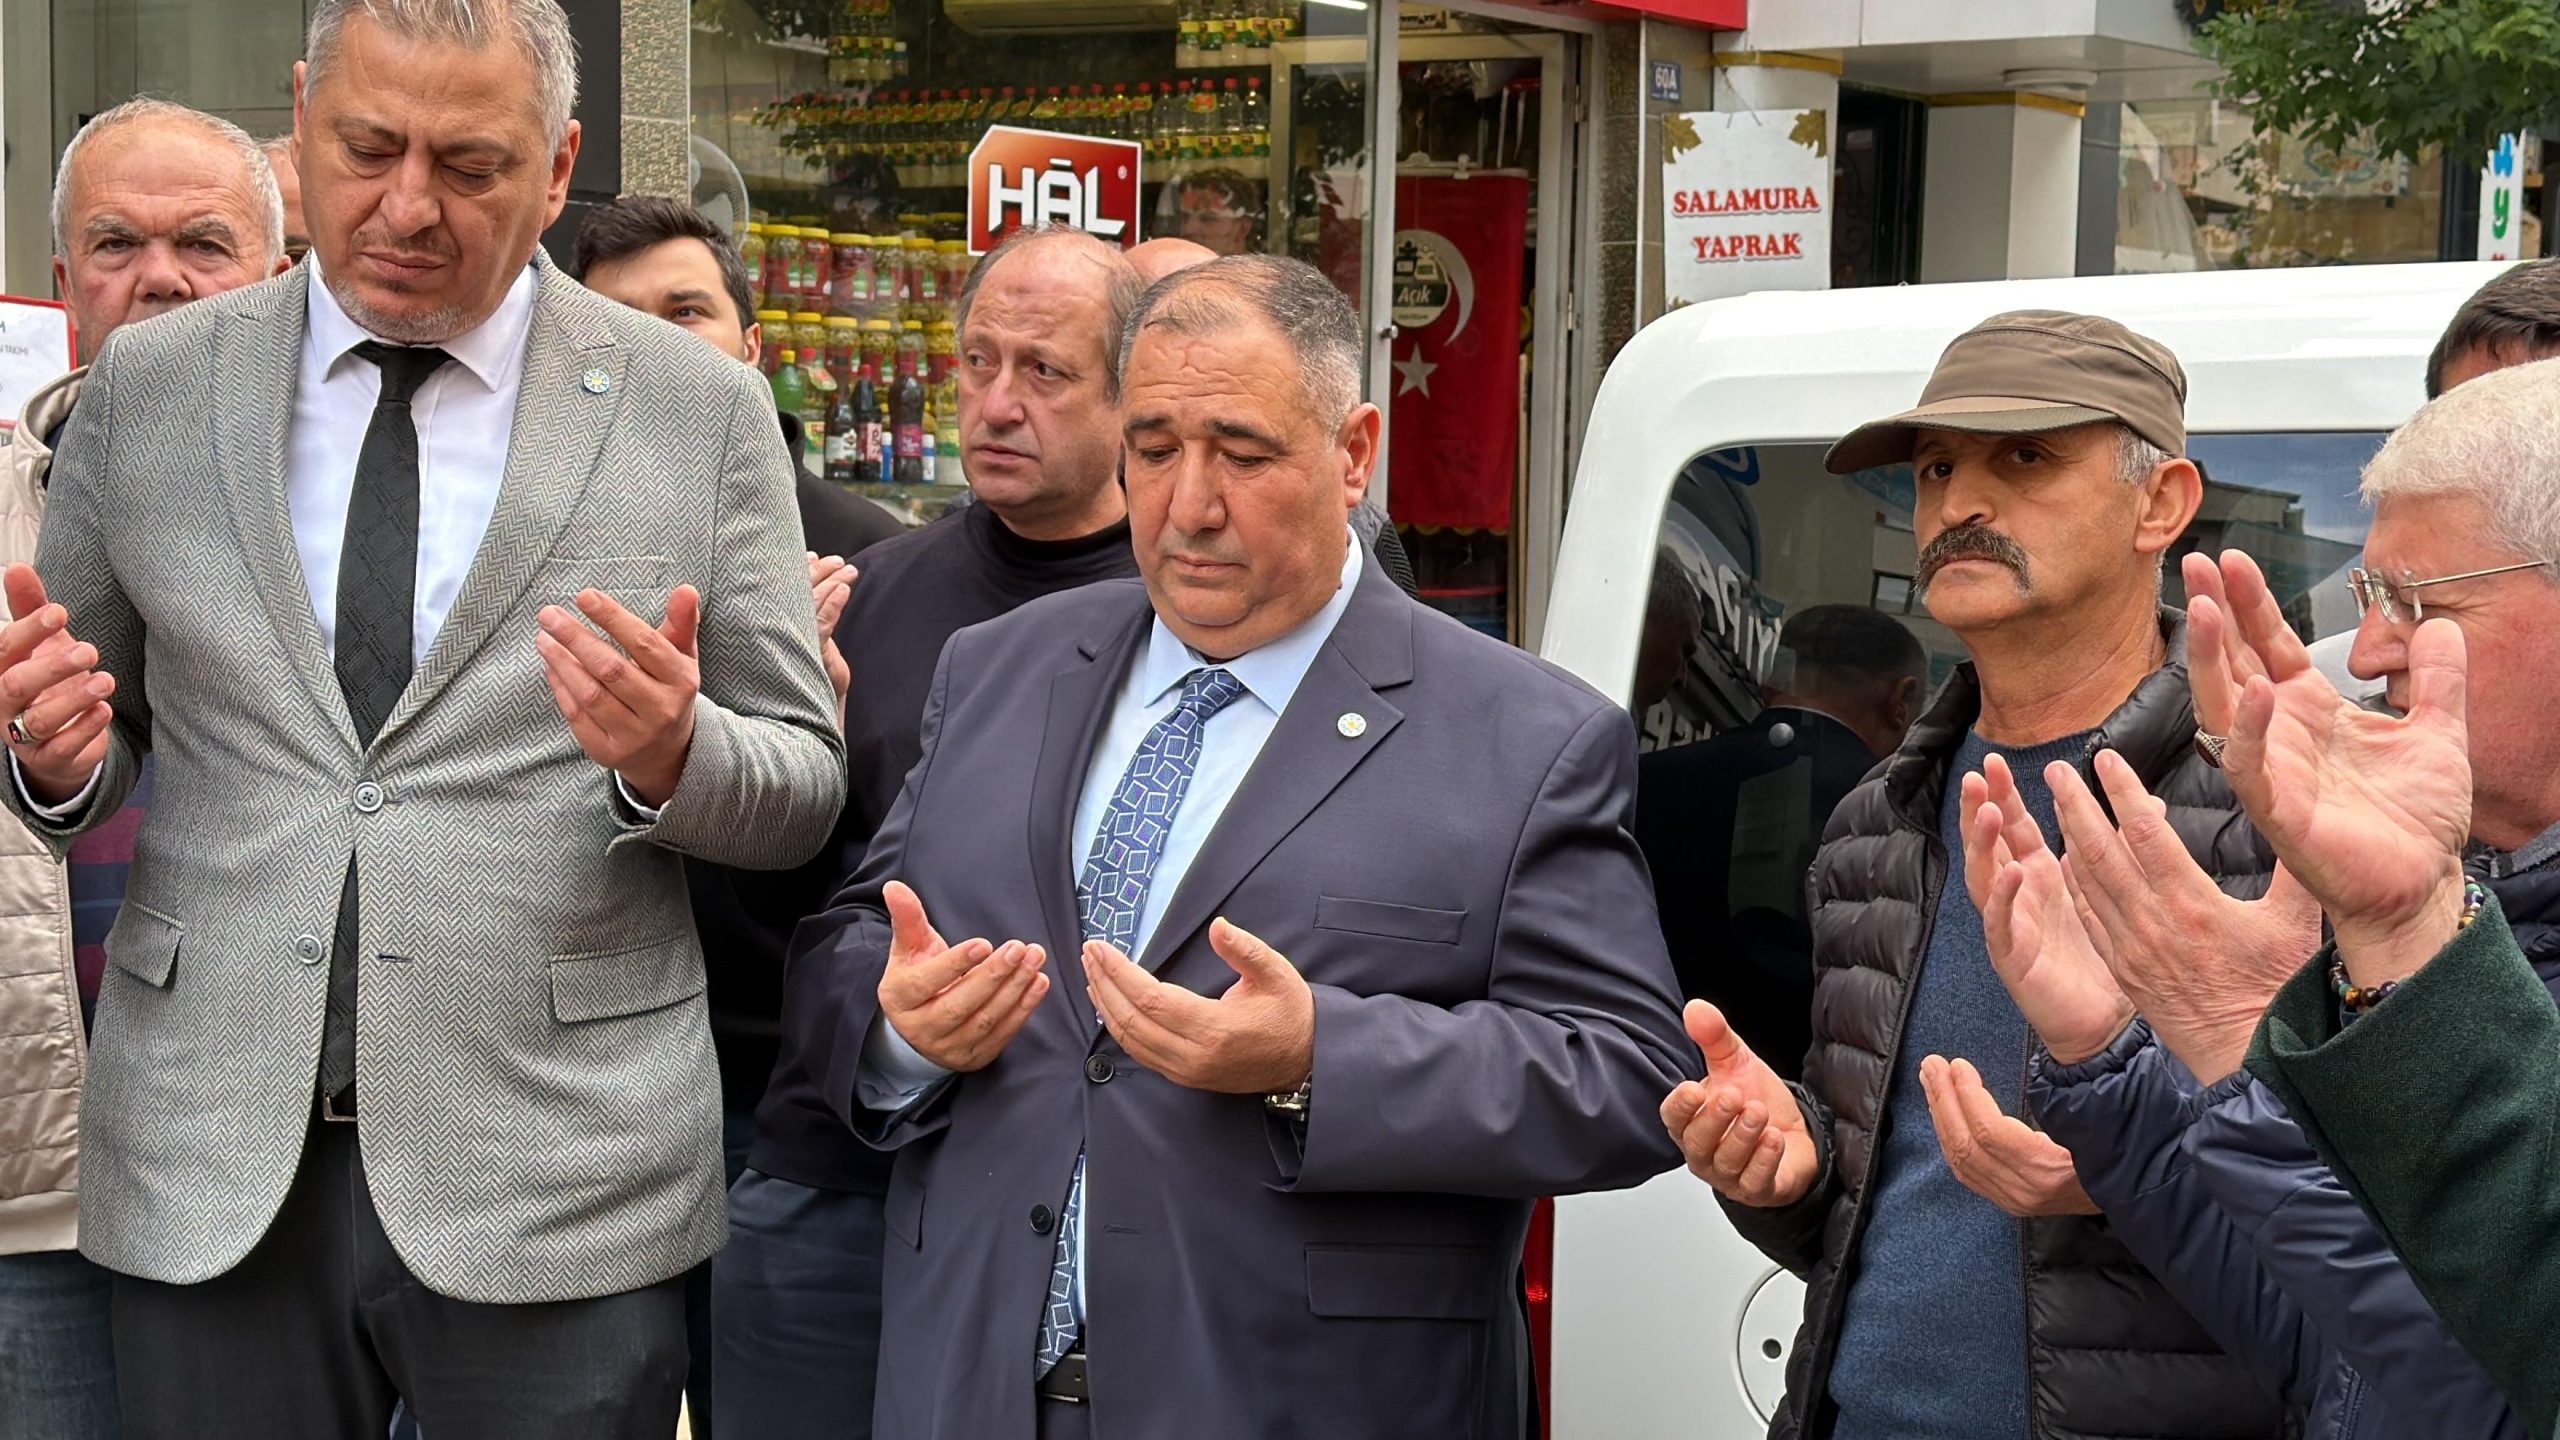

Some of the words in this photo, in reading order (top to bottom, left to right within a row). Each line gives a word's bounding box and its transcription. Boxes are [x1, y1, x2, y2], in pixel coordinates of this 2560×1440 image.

[1655, 67, 1678, 90] 60A
[1672, 186, 1820, 214] SALAMURA
[1693, 232, 1802, 260] YAPRAK
[1397, 284, 1431, 306] Açık
